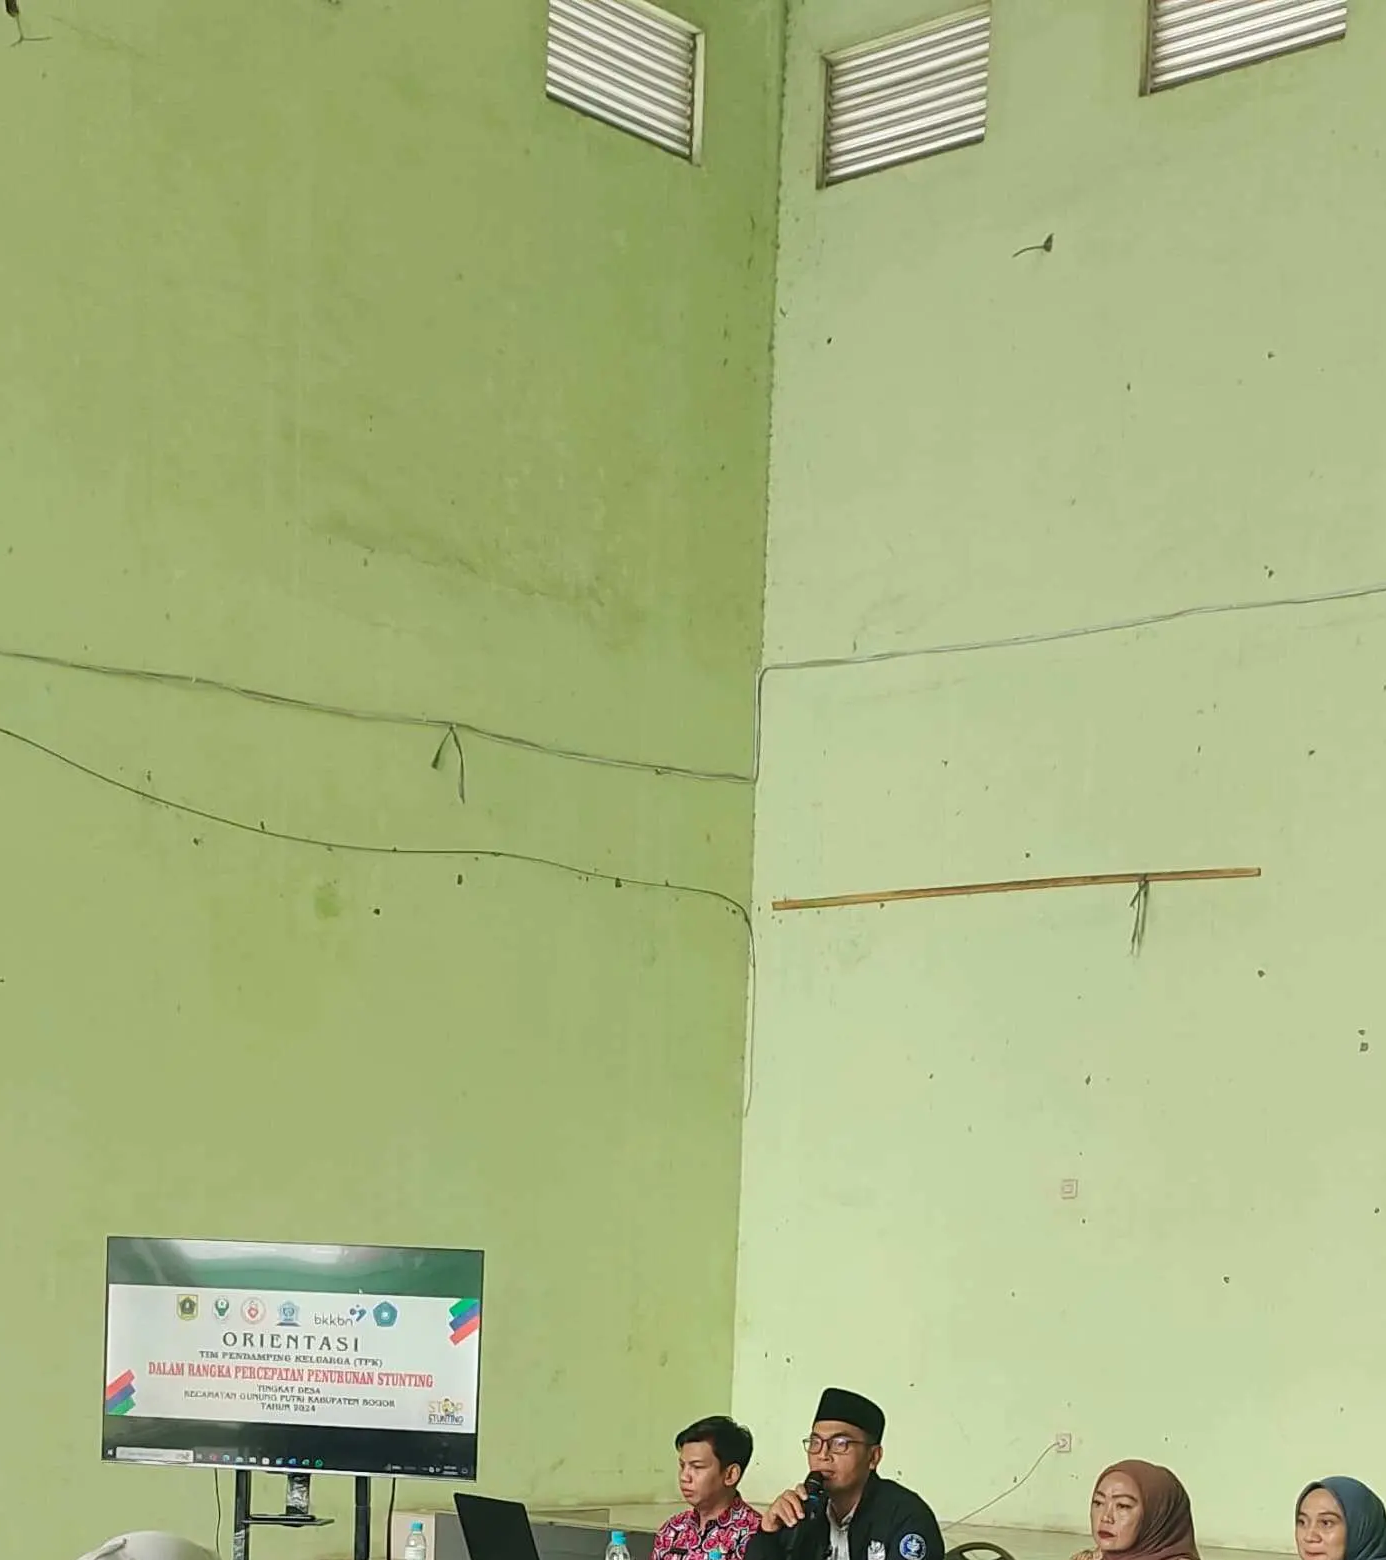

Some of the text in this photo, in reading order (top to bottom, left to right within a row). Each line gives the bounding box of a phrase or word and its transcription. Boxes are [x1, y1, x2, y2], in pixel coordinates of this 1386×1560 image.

[314, 1313, 353, 1327] bkkbn
[222, 1332, 359, 1352] ORIENTASI
[199, 1350, 219, 1359] TIM
[222, 1352, 291, 1362] PENDAMPING
[148, 1362, 434, 1388] DALAM RANGKA PERCEPATAN PENURUNAN STUNTING
[257, 1384, 294, 1393] TINGKAT
[427, 1414, 464, 1424] STUNTING
